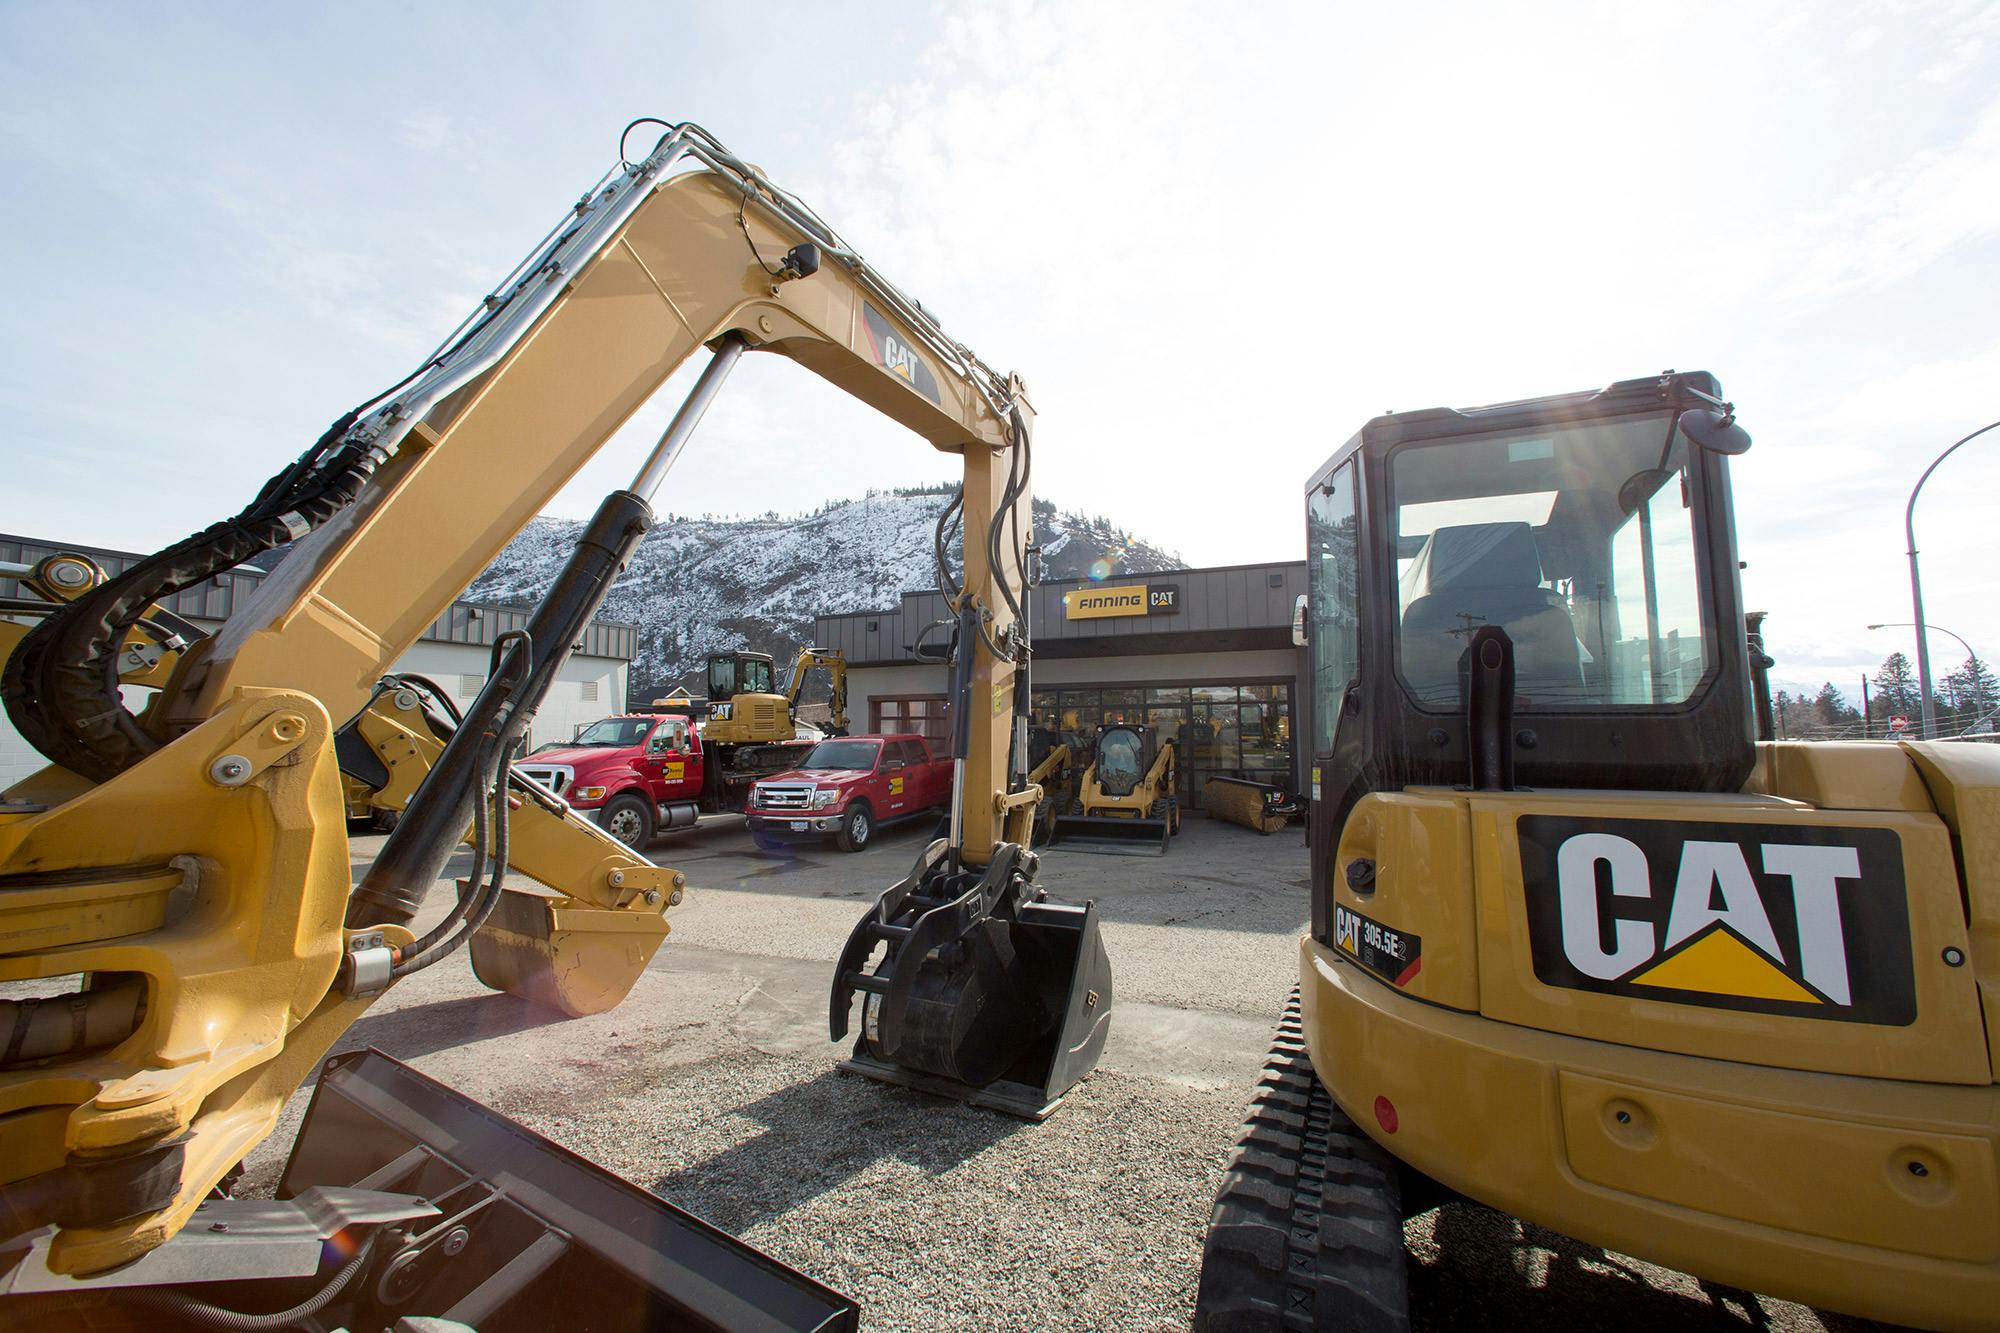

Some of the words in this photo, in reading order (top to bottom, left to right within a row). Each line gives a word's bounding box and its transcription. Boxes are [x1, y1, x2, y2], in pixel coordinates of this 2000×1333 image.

[885, 336, 918, 384] CAT
[1079, 595, 1141, 609] FINNING
[1151, 591, 1174, 606] CAT
[1336, 907, 1361, 957] CAT
[1364, 921, 1407, 961] 305.5E2
[1556, 832, 1862, 1006] CAT
